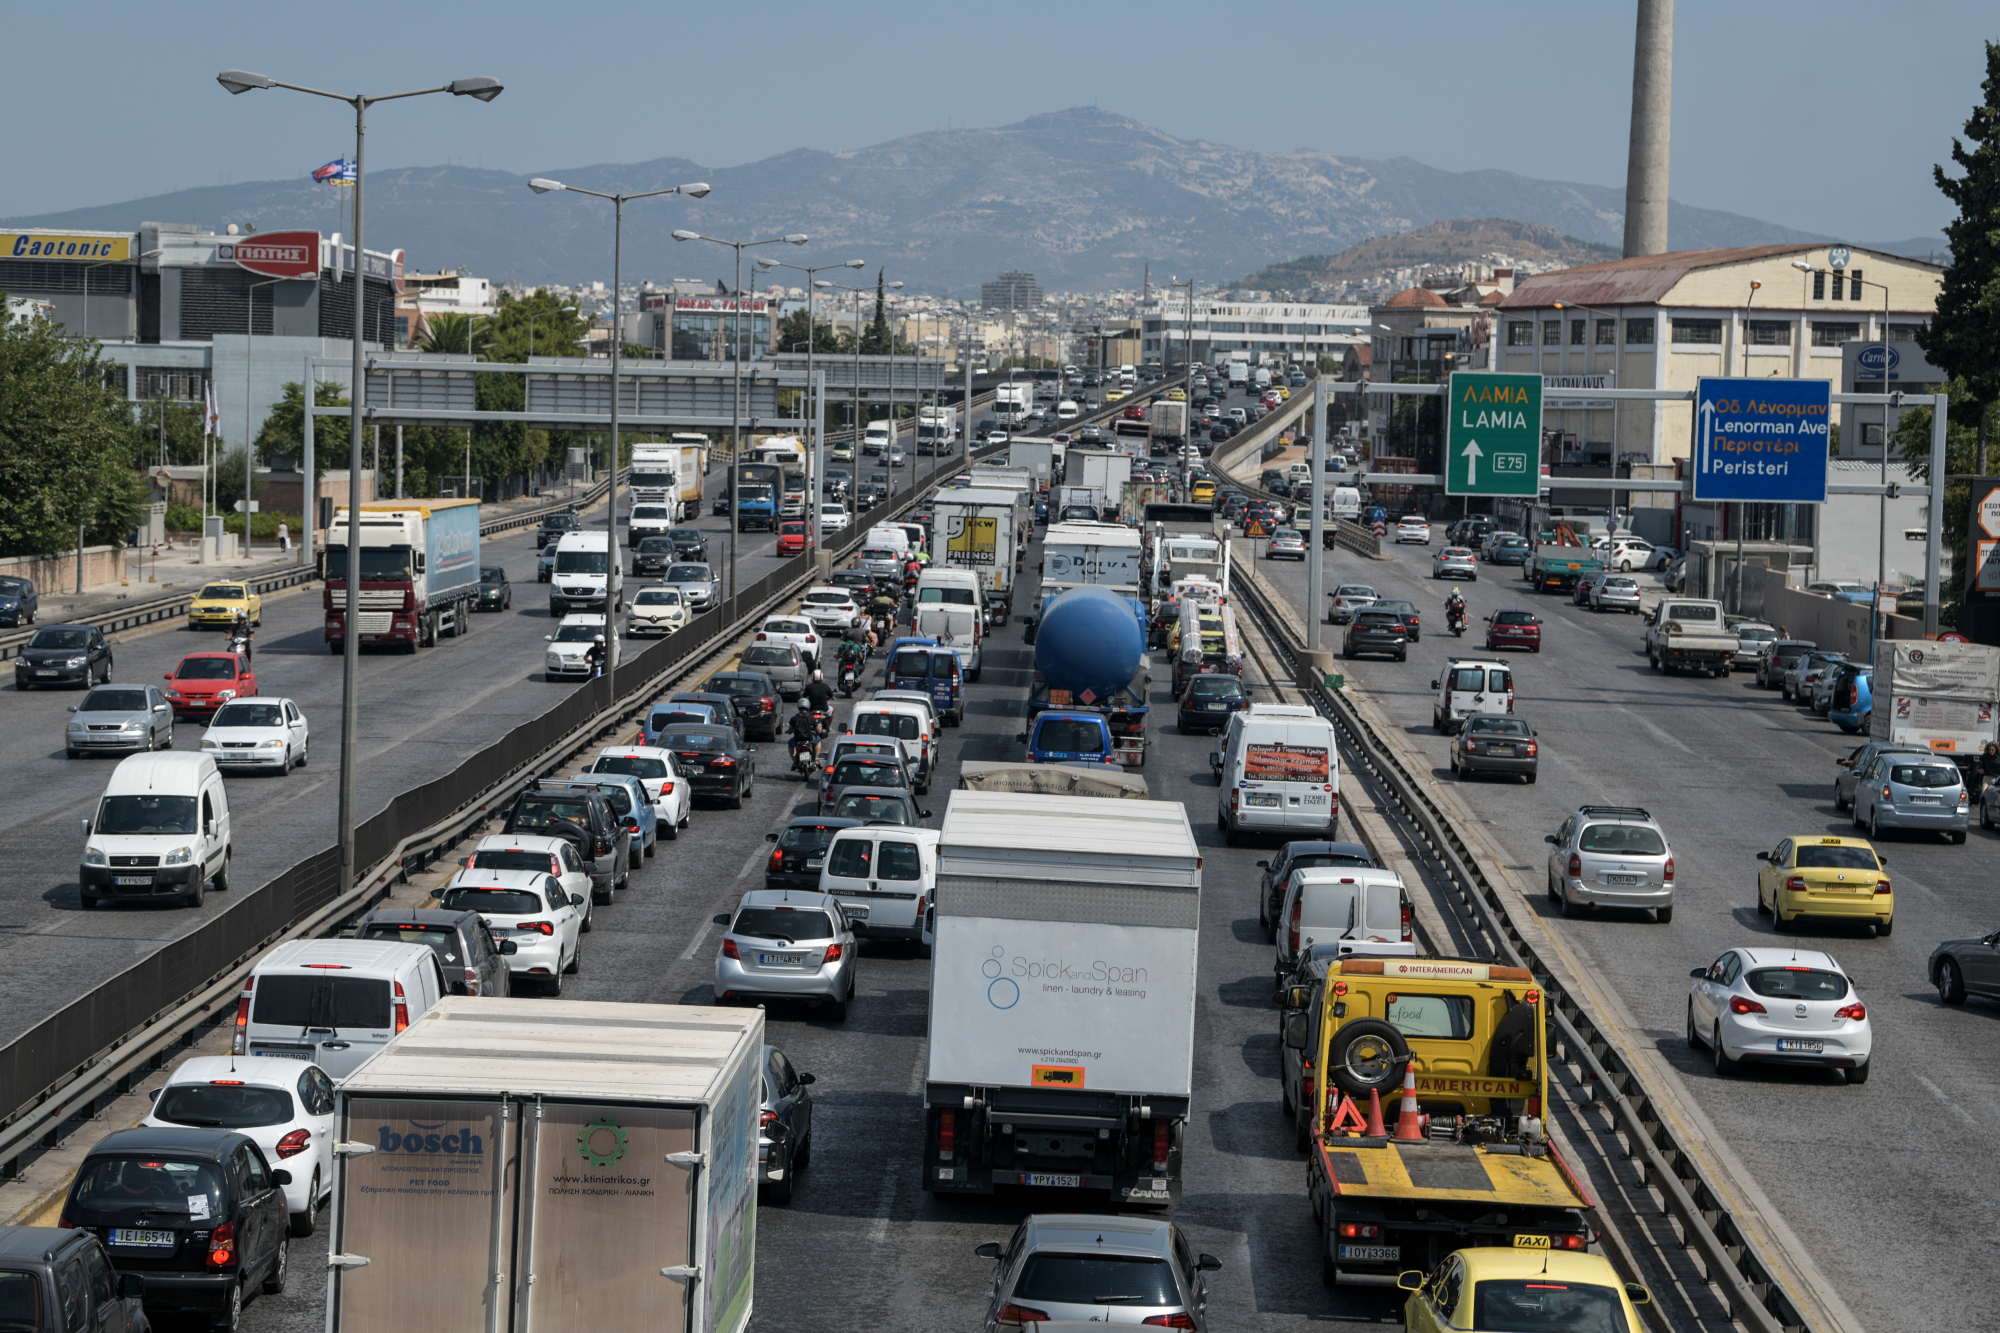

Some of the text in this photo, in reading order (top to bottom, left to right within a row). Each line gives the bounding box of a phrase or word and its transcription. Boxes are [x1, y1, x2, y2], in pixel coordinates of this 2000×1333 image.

[12, 235, 112, 256] Caotonic
[238, 248, 302, 260] ΓΙΩΤΗΣ
[677, 299, 711, 309] BREAD
[1862, 351, 1892, 363] Carrir
[1464, 385, 1528, 404] ΛΑΜΙΑ
[1716, 399, 1827, 418] Οδ. Λένορμαν
[1463, 410, 1527, 429] LAMIA
[1715, 418, 1827, 434] Lenorman Ave
[1714, 436, 1799, 456] Περιστέρι
[1713, 459, 1788, 475] Peristeri
[968, 520, 994, 528] LKW
[948, 550, 994, 560] FRIENDS
[1980, 549, 2000, 557] ΠΤΥΣΣ
[993, 780, 1048, 788] ΒΙΟΜΗΧΑΝΙΑ
[1050, 784, 1076, 792] ΕΙΔΩΝ
[1410, 966, 1472, 974] INTERAMERICAN
[1042, 984, 1063, 993] linen
[1072, 985, 1104, 996] laundry
[1106, 987, 1112, 996] &
[1115, 987, 1146, 999] leasing
[1018, 1047, 1102, 1059] www.spickandspan.gr
[1414, 1080, 1520, 1094] RAMERICAN
[378, 1126, 484, 1154] bosch
[553, 1174, 650, 1187] www.ktiniatrikos.gr
[360, 1186, 396, 1194] Εξαιρετική
[398, 1187, 428, 1195] ποιότητα
[448, 1189, 479, 1197] καλύτερη
[582, 1188, 618, 1196] ΧΟΝΔΡΙΚΗ
[1121, 1187, 1170, 1199] SCANIA
[1517, 1236, 1548, 1246] TAXI
